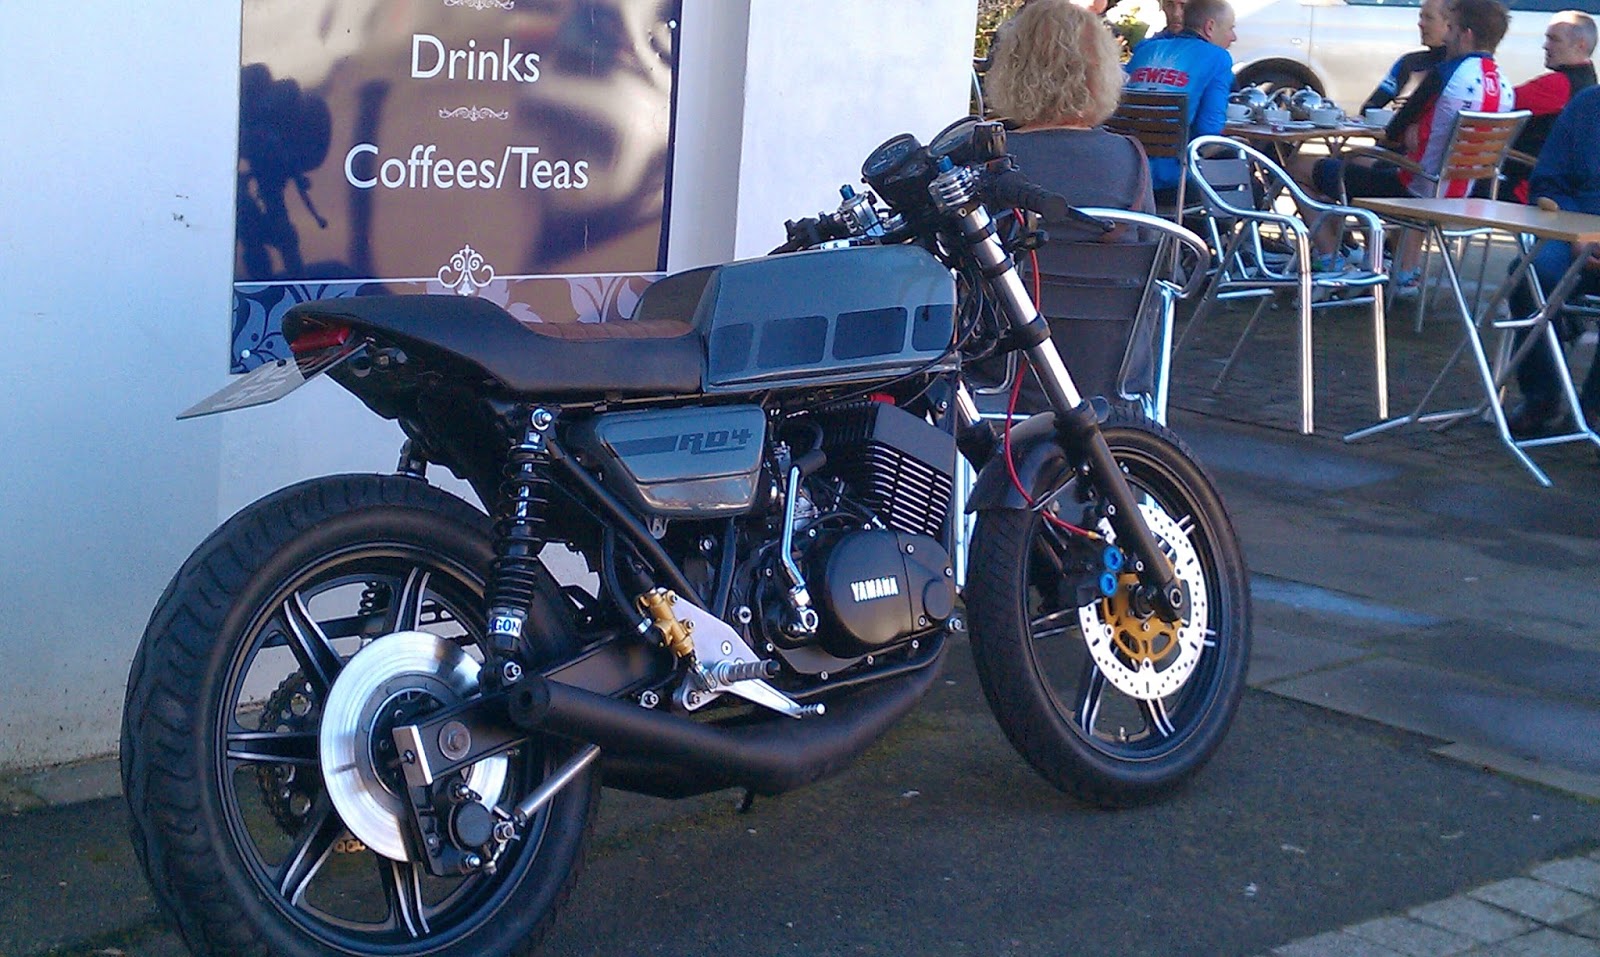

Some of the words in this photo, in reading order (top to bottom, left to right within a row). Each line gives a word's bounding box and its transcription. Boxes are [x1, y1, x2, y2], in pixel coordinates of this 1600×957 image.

[410, 33, 541, 83] Drinks
[343, 142, 590, 190] Coffees/Teas
[850, 575, 899, 602] YAMAHA
[490, 618, 521, 634] GON
